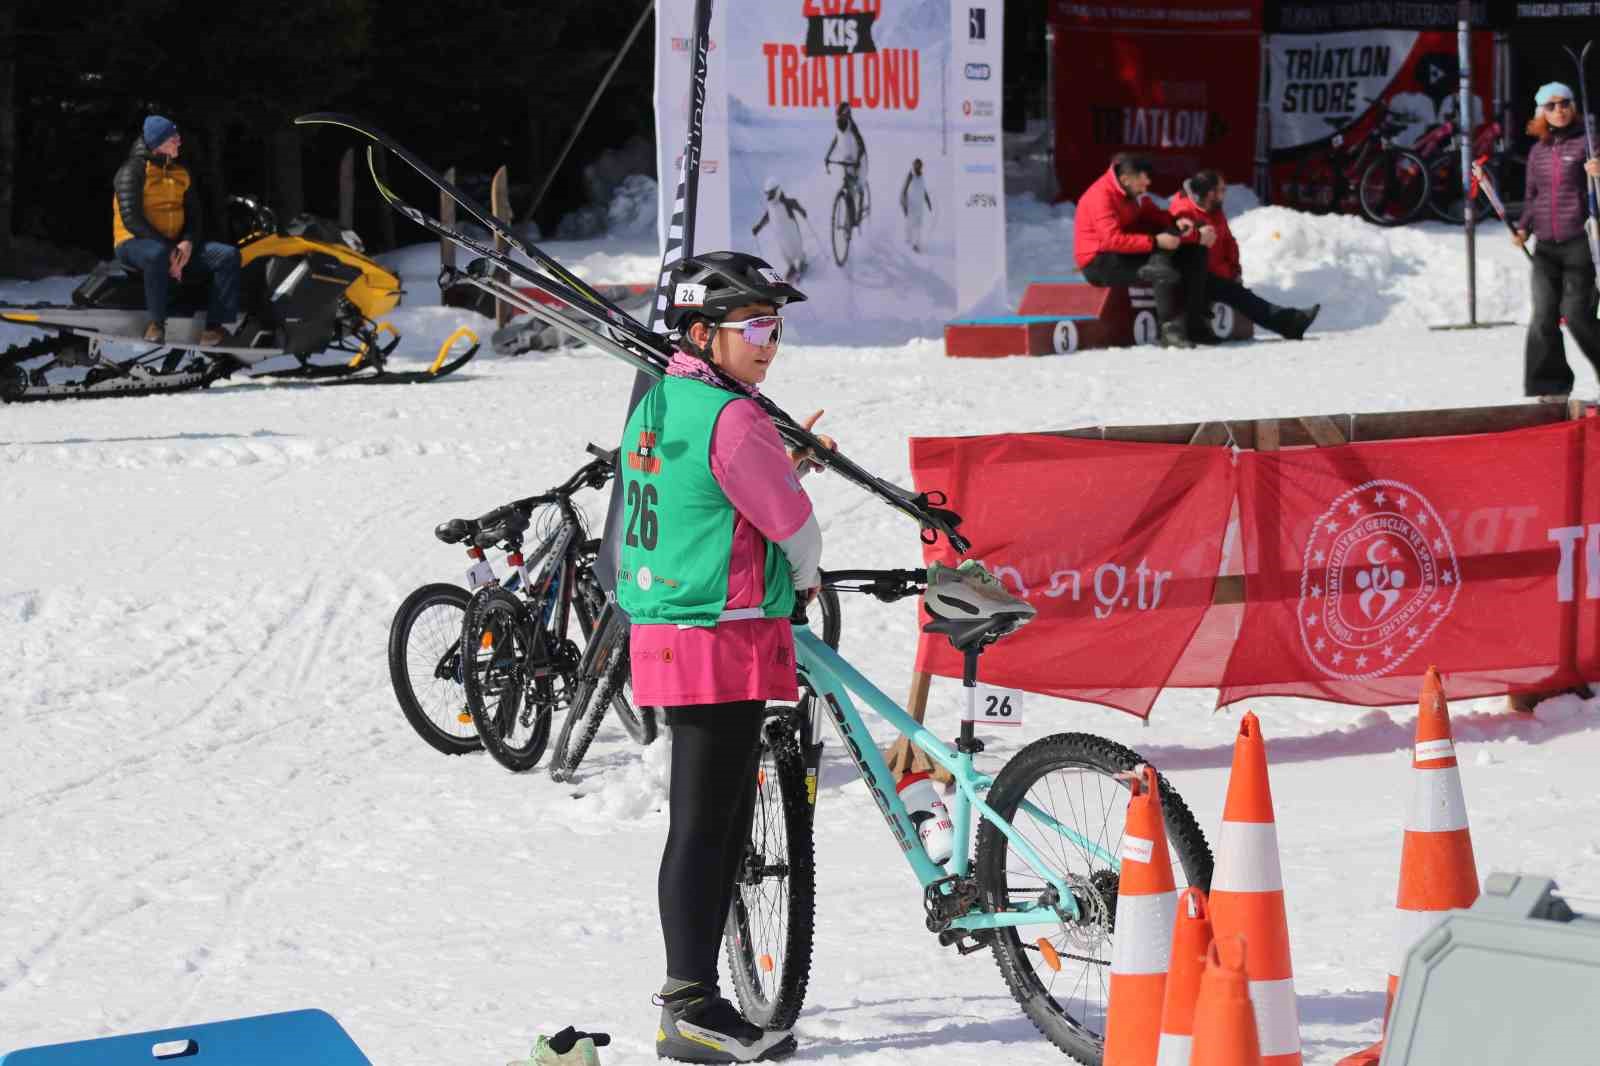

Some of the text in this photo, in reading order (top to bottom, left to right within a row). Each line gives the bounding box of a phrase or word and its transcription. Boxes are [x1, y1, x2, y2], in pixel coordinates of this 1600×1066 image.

[823, 18, 858, 53] KIŞ
[763, 43, 920, 110] TRİATLONU
[1284, 42, 1391, 80] TRİATLON
[1282, 81, 1359, 114] STORE
[682, 289, 695, 303] 26
[1216, 305, 1226, 330] 2
[1060, 327, 1070, 351] 3
[626, 480, 659, 551] 26
[985, 695, 1013, 717] 26
